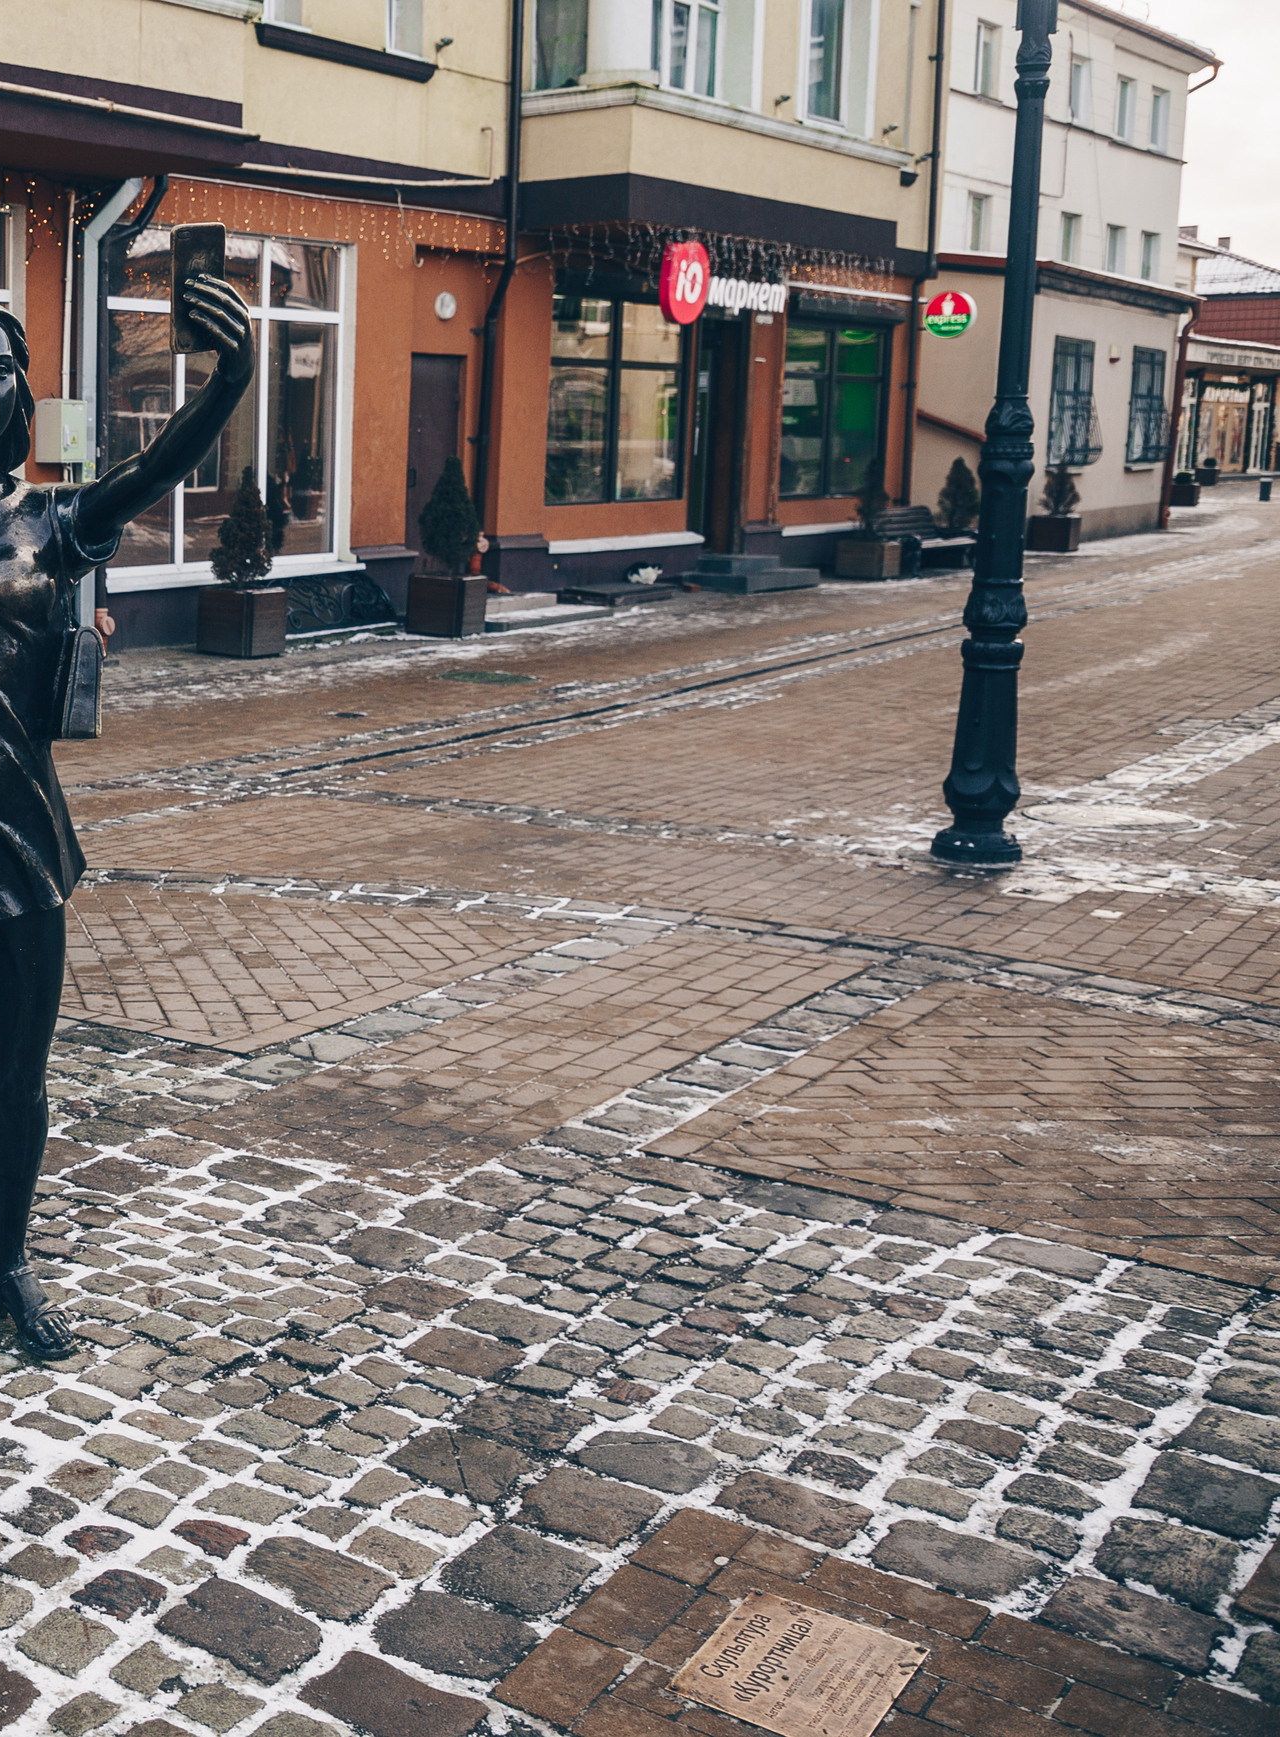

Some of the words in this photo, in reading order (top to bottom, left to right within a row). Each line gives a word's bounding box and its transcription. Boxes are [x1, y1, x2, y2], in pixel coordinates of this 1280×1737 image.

[700, 1613, 771, 1678] Скульптура
[733, 1618, 814, 1703] «Курортница»
[765, 1701, 786, 1720] Автор
